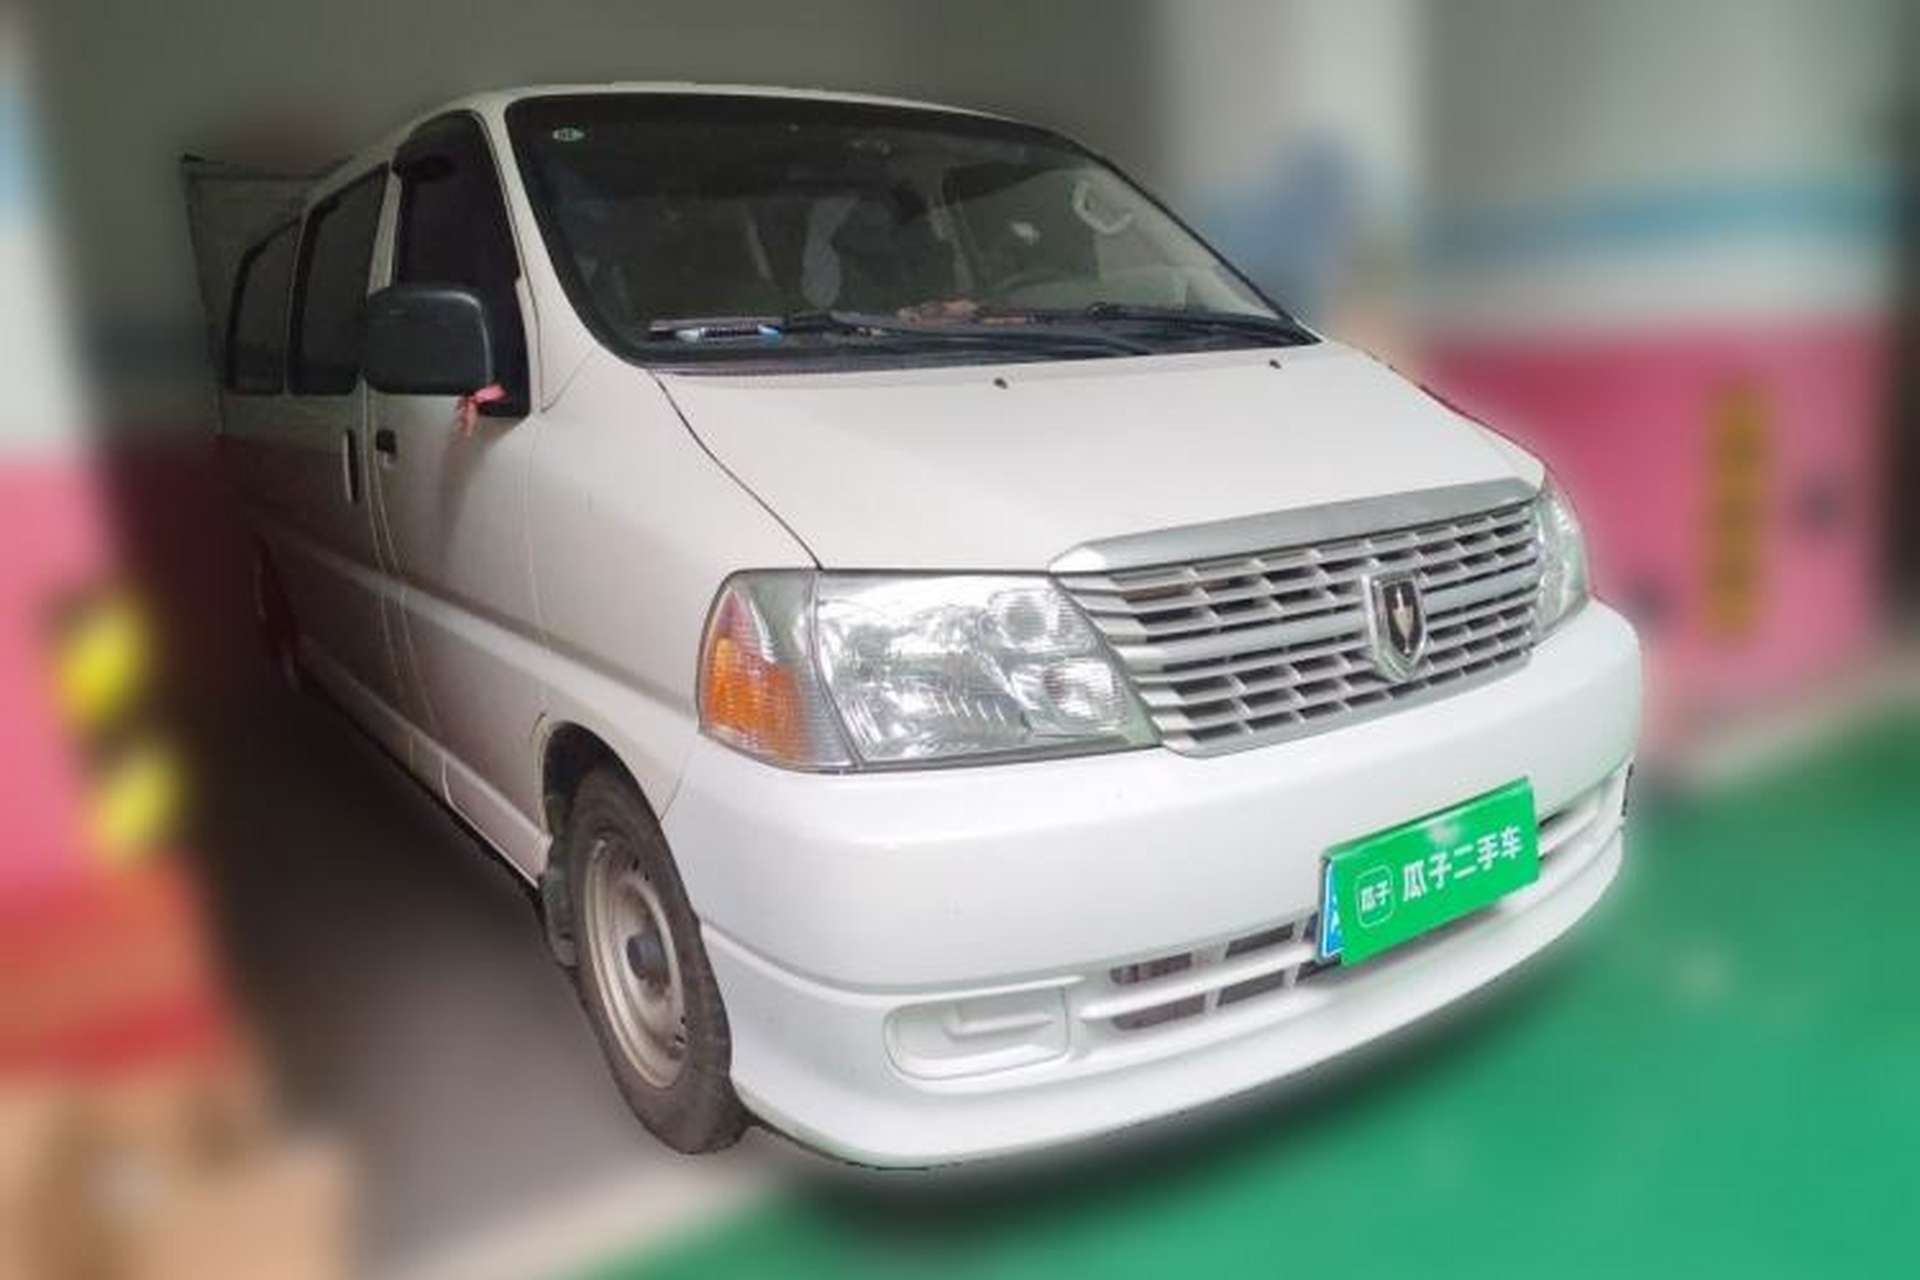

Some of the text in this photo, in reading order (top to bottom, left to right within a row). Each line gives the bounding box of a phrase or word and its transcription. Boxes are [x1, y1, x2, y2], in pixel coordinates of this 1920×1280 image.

[1403, 825, 1521, 901] 瓜子二手车
[1360, 880, 1390, 912] 瓜子
